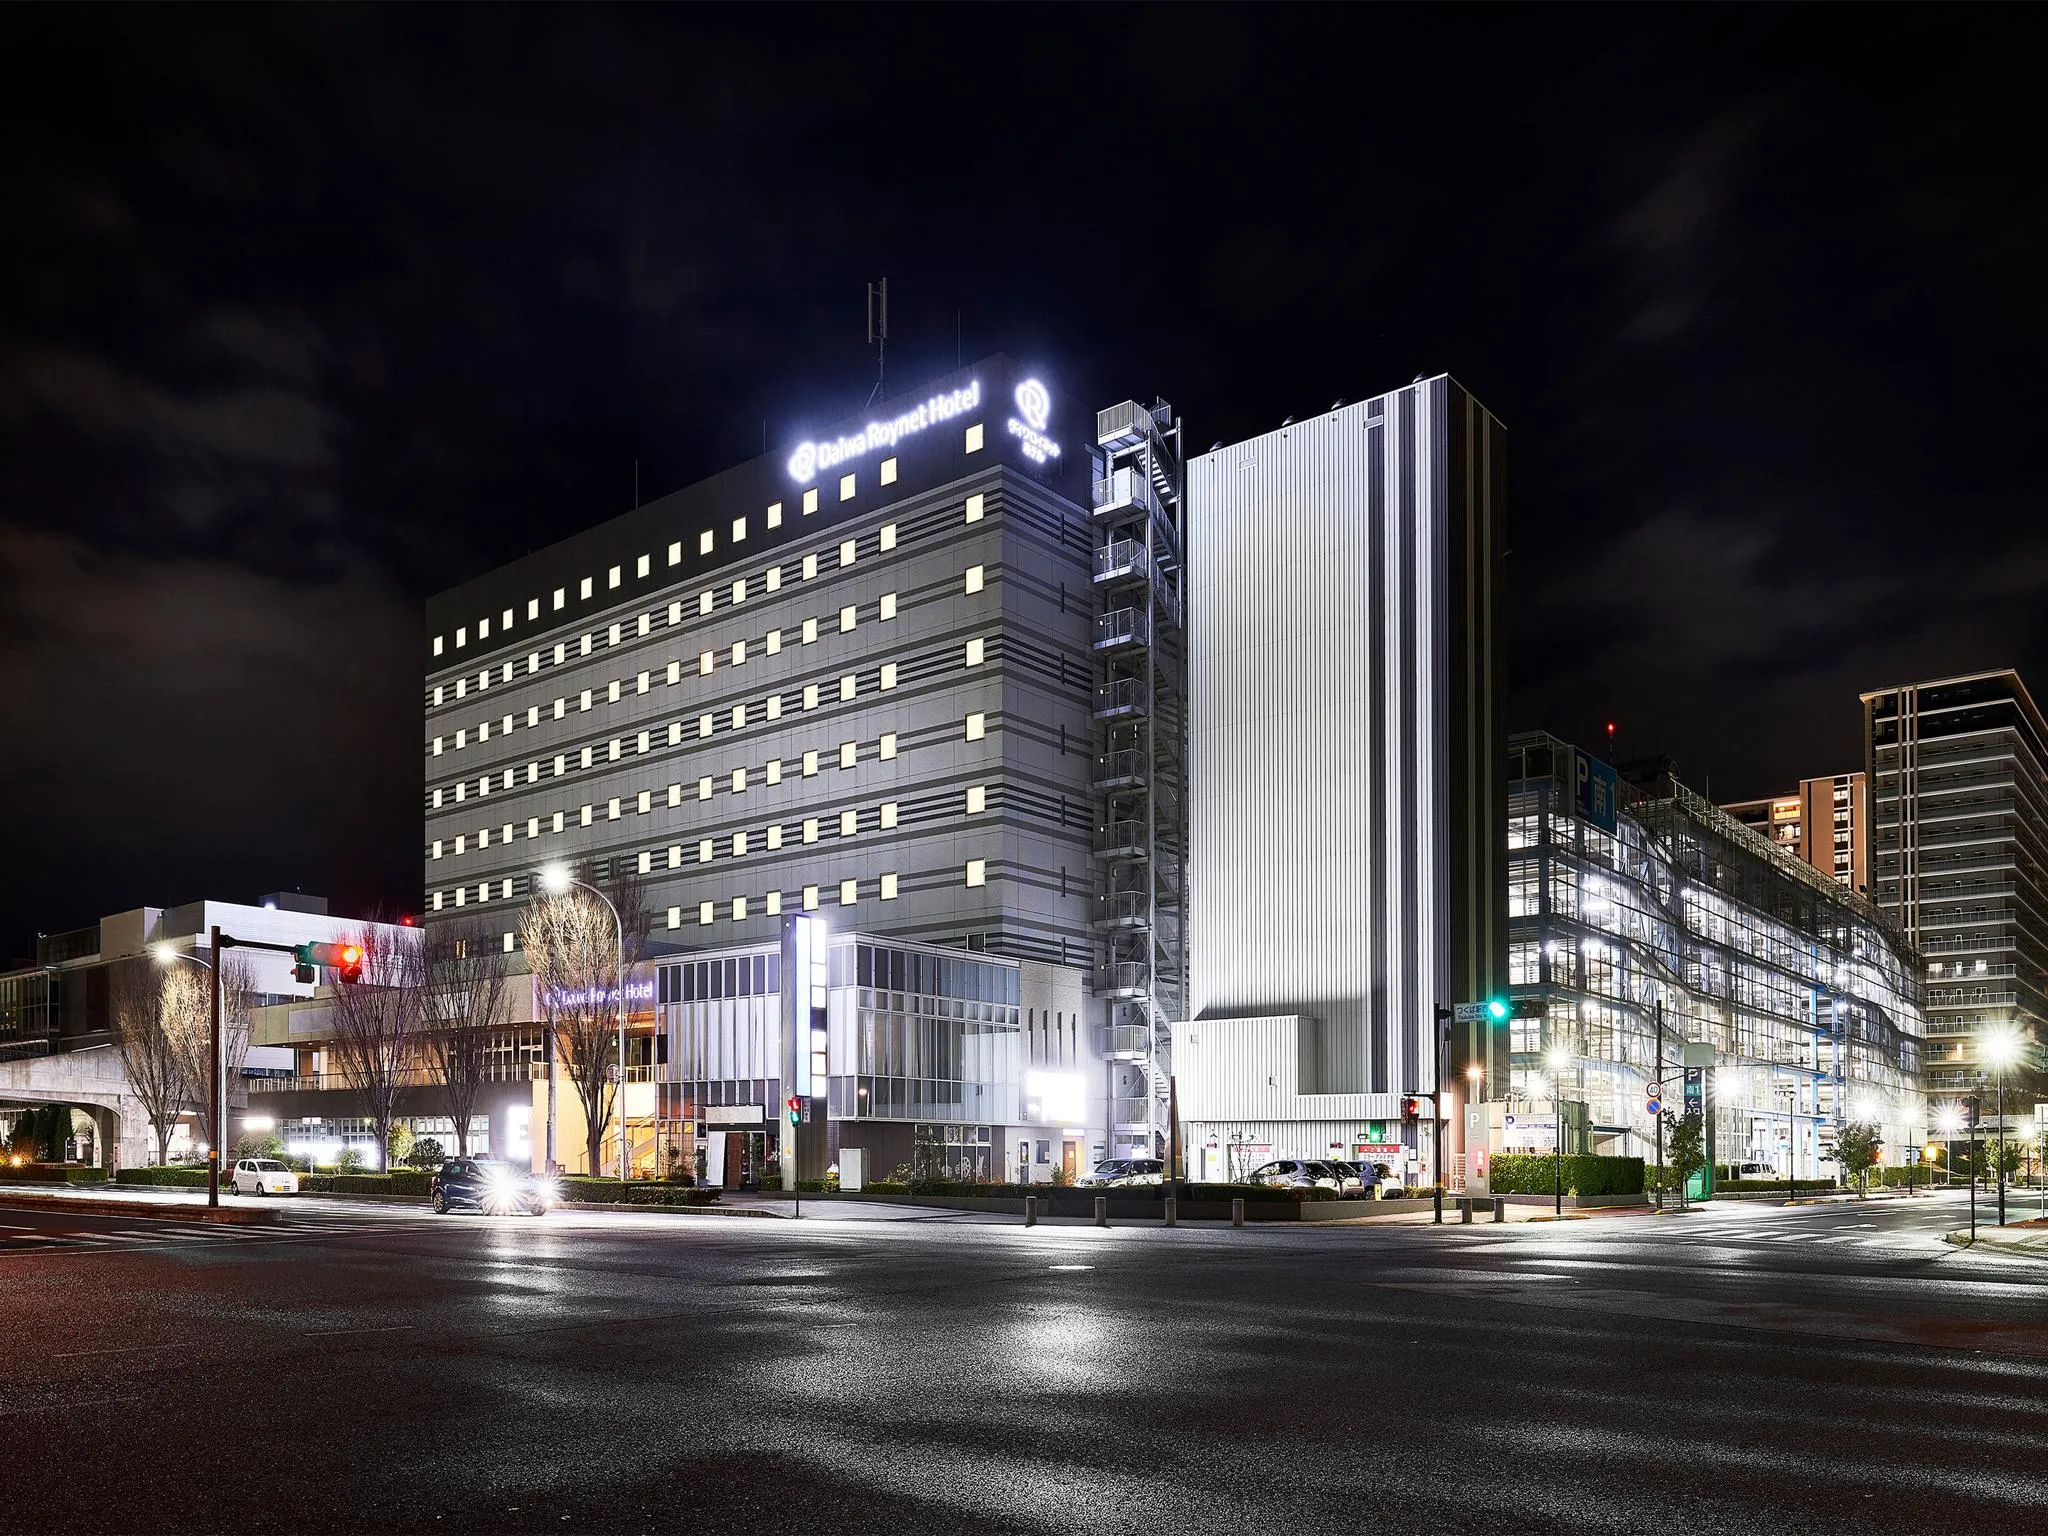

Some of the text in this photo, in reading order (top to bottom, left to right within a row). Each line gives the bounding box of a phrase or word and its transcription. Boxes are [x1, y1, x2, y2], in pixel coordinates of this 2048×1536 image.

[817, 380, 980, 469] Daiwa Roynet Hotel
[1576, 755, 1589, 796] P
[625, 981, 653, 999] Hotel
[1688, 1069, 1698, 1081] P
[1650, 1086, 1658, 1094] 40
[1470, 1112, 1480, 1128] P
[1505, 1115, 1515, 1129] P
